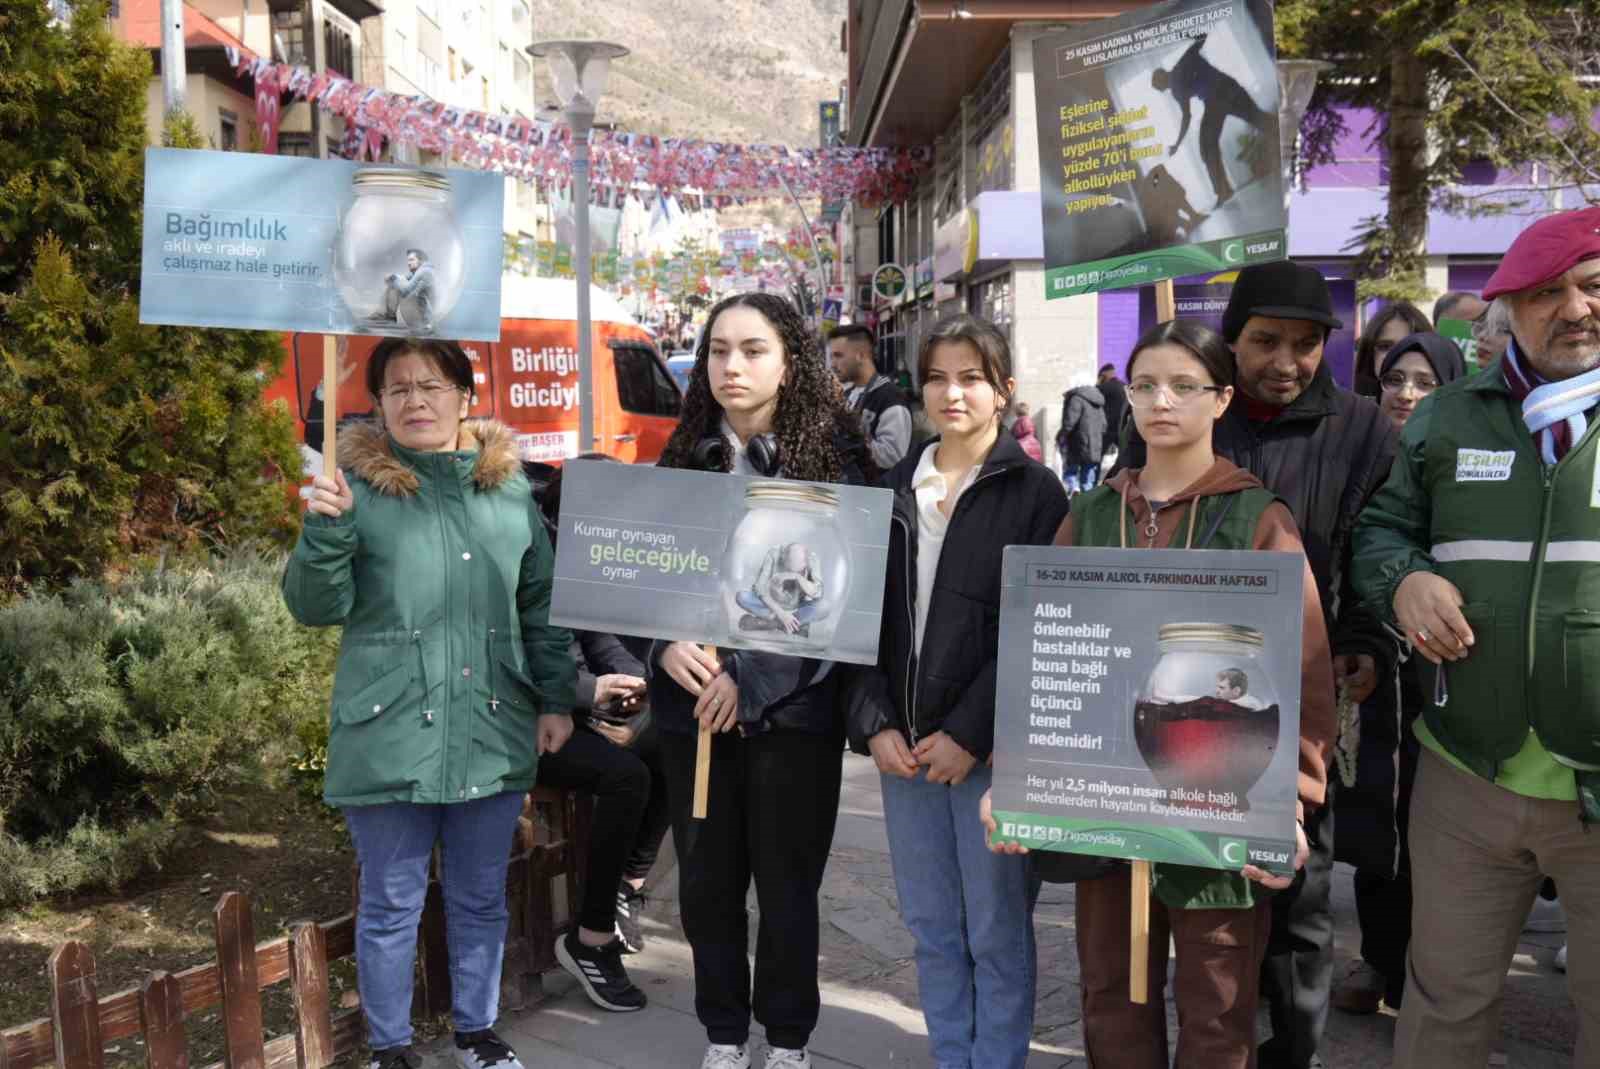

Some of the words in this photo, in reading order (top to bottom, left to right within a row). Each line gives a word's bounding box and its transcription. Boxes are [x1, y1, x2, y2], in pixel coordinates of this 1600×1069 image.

[1065, 50, 1075, 61] 25
[1075, 43, 1102, 58] KASIM
[1102, 35, 1132, 52] KADINA
[1083, 43, 1141, 66] ULUSLARARASI
[1060, 99, 1109, 121] Eşlerine
[1061, 116, 1105, 139] fiziksel
[1063, 157, 1100, 178] yüzde
[1103, 148, 1127, 167] 70'i
[1064, 168, 1136, 194] alkollüyken
[166, 213, 287, 241] Bağımlılık
[196, 242, 213, 254] ve
[163, 255, 232, 272] çalışmaz
[235, 256, 268, 273] hale
[1203, 300, 1230, 311] DÜNY
[573, 521, 618, 539] Kumar
[621, 530, 676, 546] oynayan
[590, 541, 710, 574] geleceğiyle
[601, 564, 641, 580] oynar
[1036, 569, 1067, 581] 16-20
[1068, 570, 1104, 583] KASIM
[1106, 571, 1141, 584] ALKOL
[1143, 572, 1217, 586] FARKINDALIK
[1219, 575, 1268, 587] HAFTASI
[1034, 603, 1072, 619] Alkol
[1033, 621, 1112, 639] önlenebilir
[1032, 639, 1111, 657] hastalıklar
[1113, 645, 1132, 658] ve
[1032, 657, 1068, 673] buna
[1071, 660, 1108, 679] bağlı
[1031, 676, 1101, 694] ölümlerin
[1030, 693, 1083, 712] üçüncü
[1030, 713, 1071, 728] temel
[1028, 731, 1103, 750] nedenidir!
[1026, 774, 1048, 788] Her
[1049, 777, 1064, 791] yıl
[1065, 777, 1086, 792] 2,5
[1087, 779, 1130, 797] milyon
[1132, 782, 1168, 799] insan
[1169, 786, 1206, 802] alkole
[1208, 788, 1238, 808] bağlı
[1026, 790, 1098, 809] nedenlerden
[1100, 796, 1148, 814] hayatını
